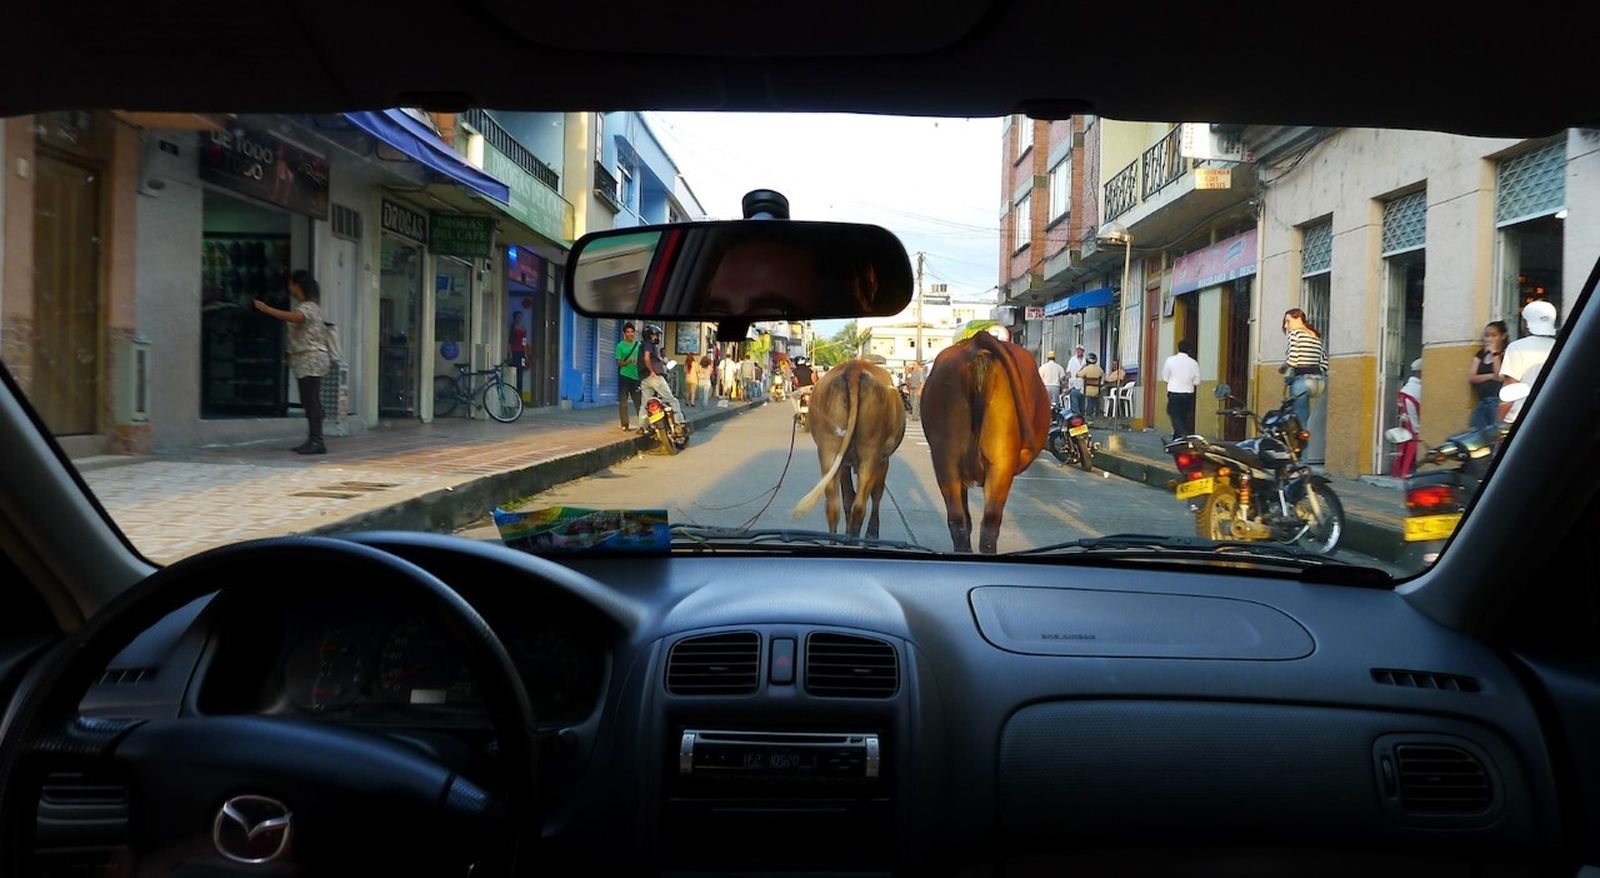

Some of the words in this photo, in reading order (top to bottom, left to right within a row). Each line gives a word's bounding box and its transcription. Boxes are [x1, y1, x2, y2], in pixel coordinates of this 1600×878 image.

[211, 130, 233, 149] DE
[236, 132, 273, 164] TODO
[492, 153, 531, 200] DROGAS
[383, 202, 424, 240] DROGAS
[438, 216, 484, 230] DROGAS
